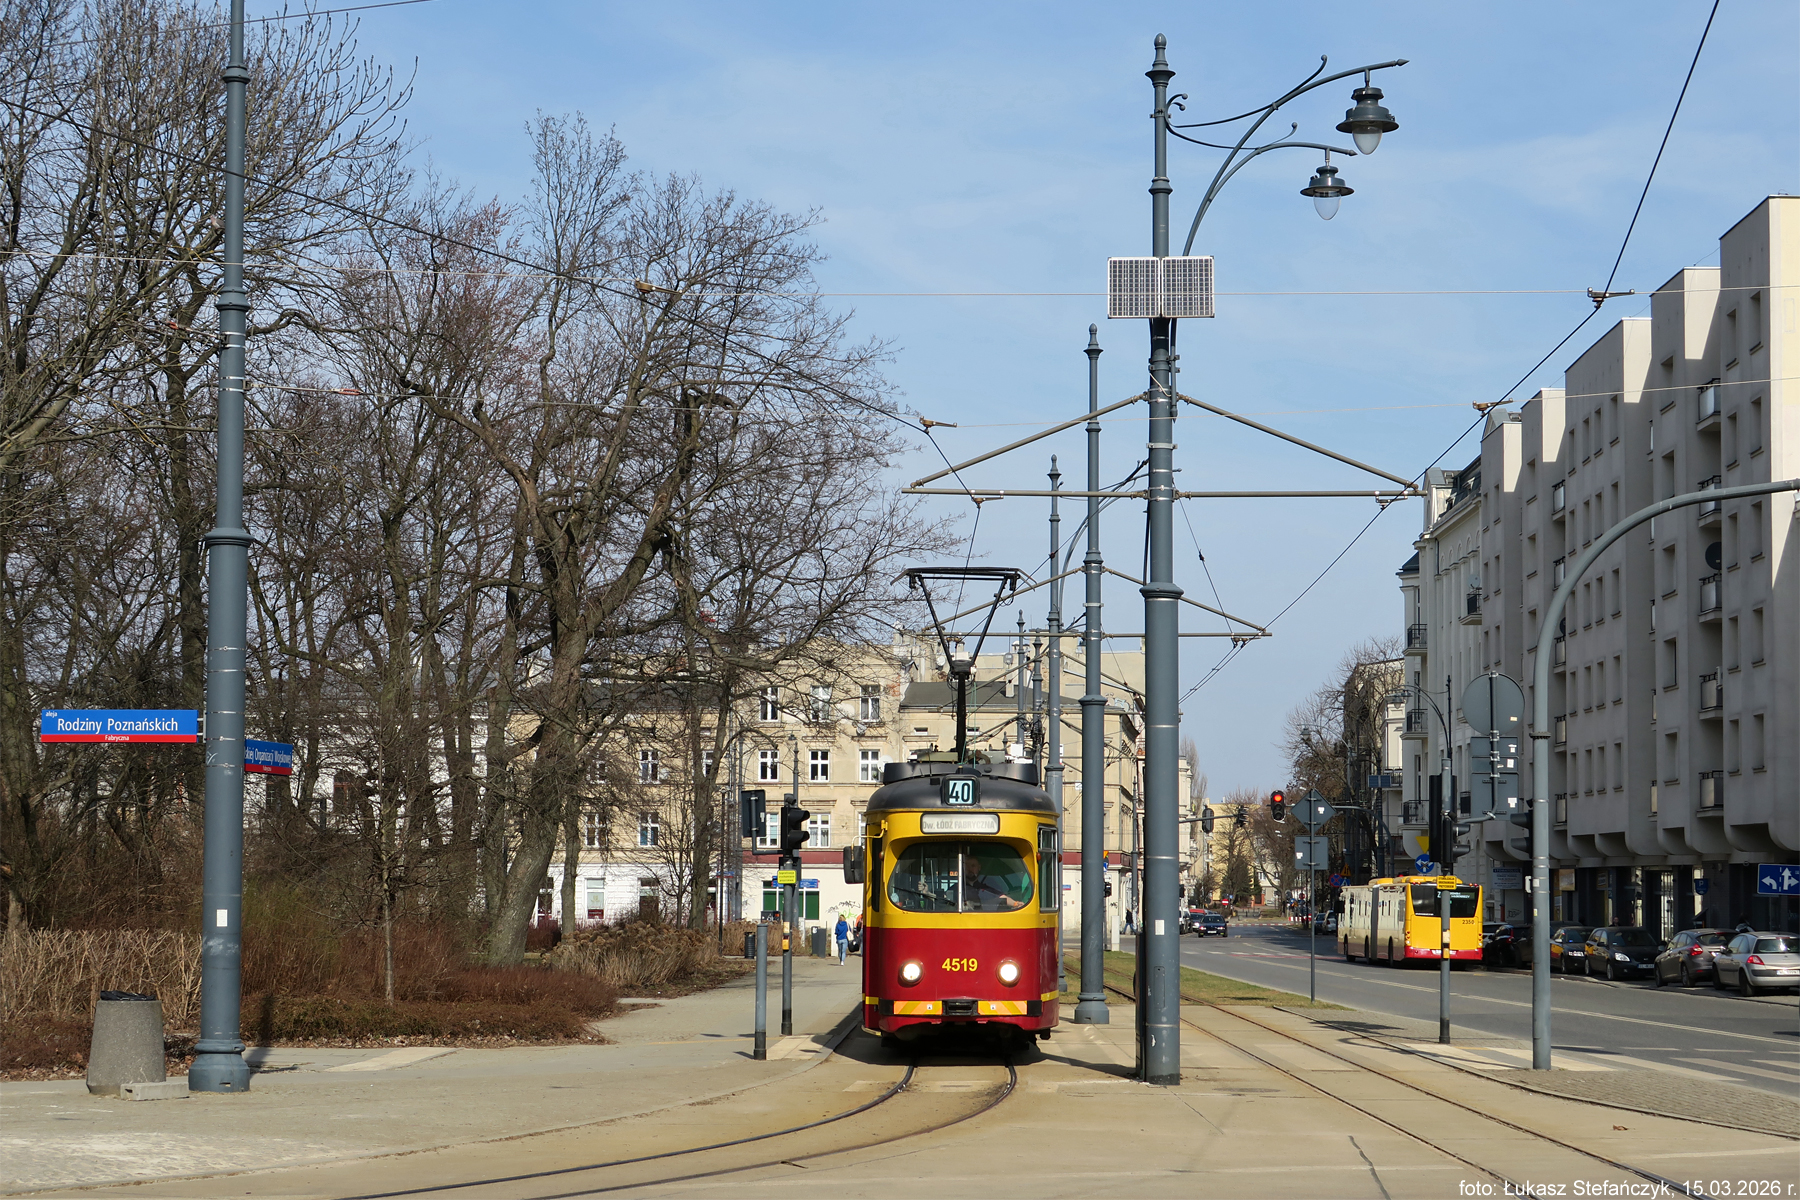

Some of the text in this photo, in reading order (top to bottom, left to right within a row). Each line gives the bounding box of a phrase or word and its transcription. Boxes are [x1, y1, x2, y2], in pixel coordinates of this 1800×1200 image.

[57, 717, 178, 735] Rodziny Poznańskich
[104, 734, 130, 743] Fabryczna
[949, 782, 971, 803] 40
[936, 818, 954, 830] ŁÓDŹ
[954, 820, 995, 830] FABRYCZNA
[941, 957, 978, 972] 4519
